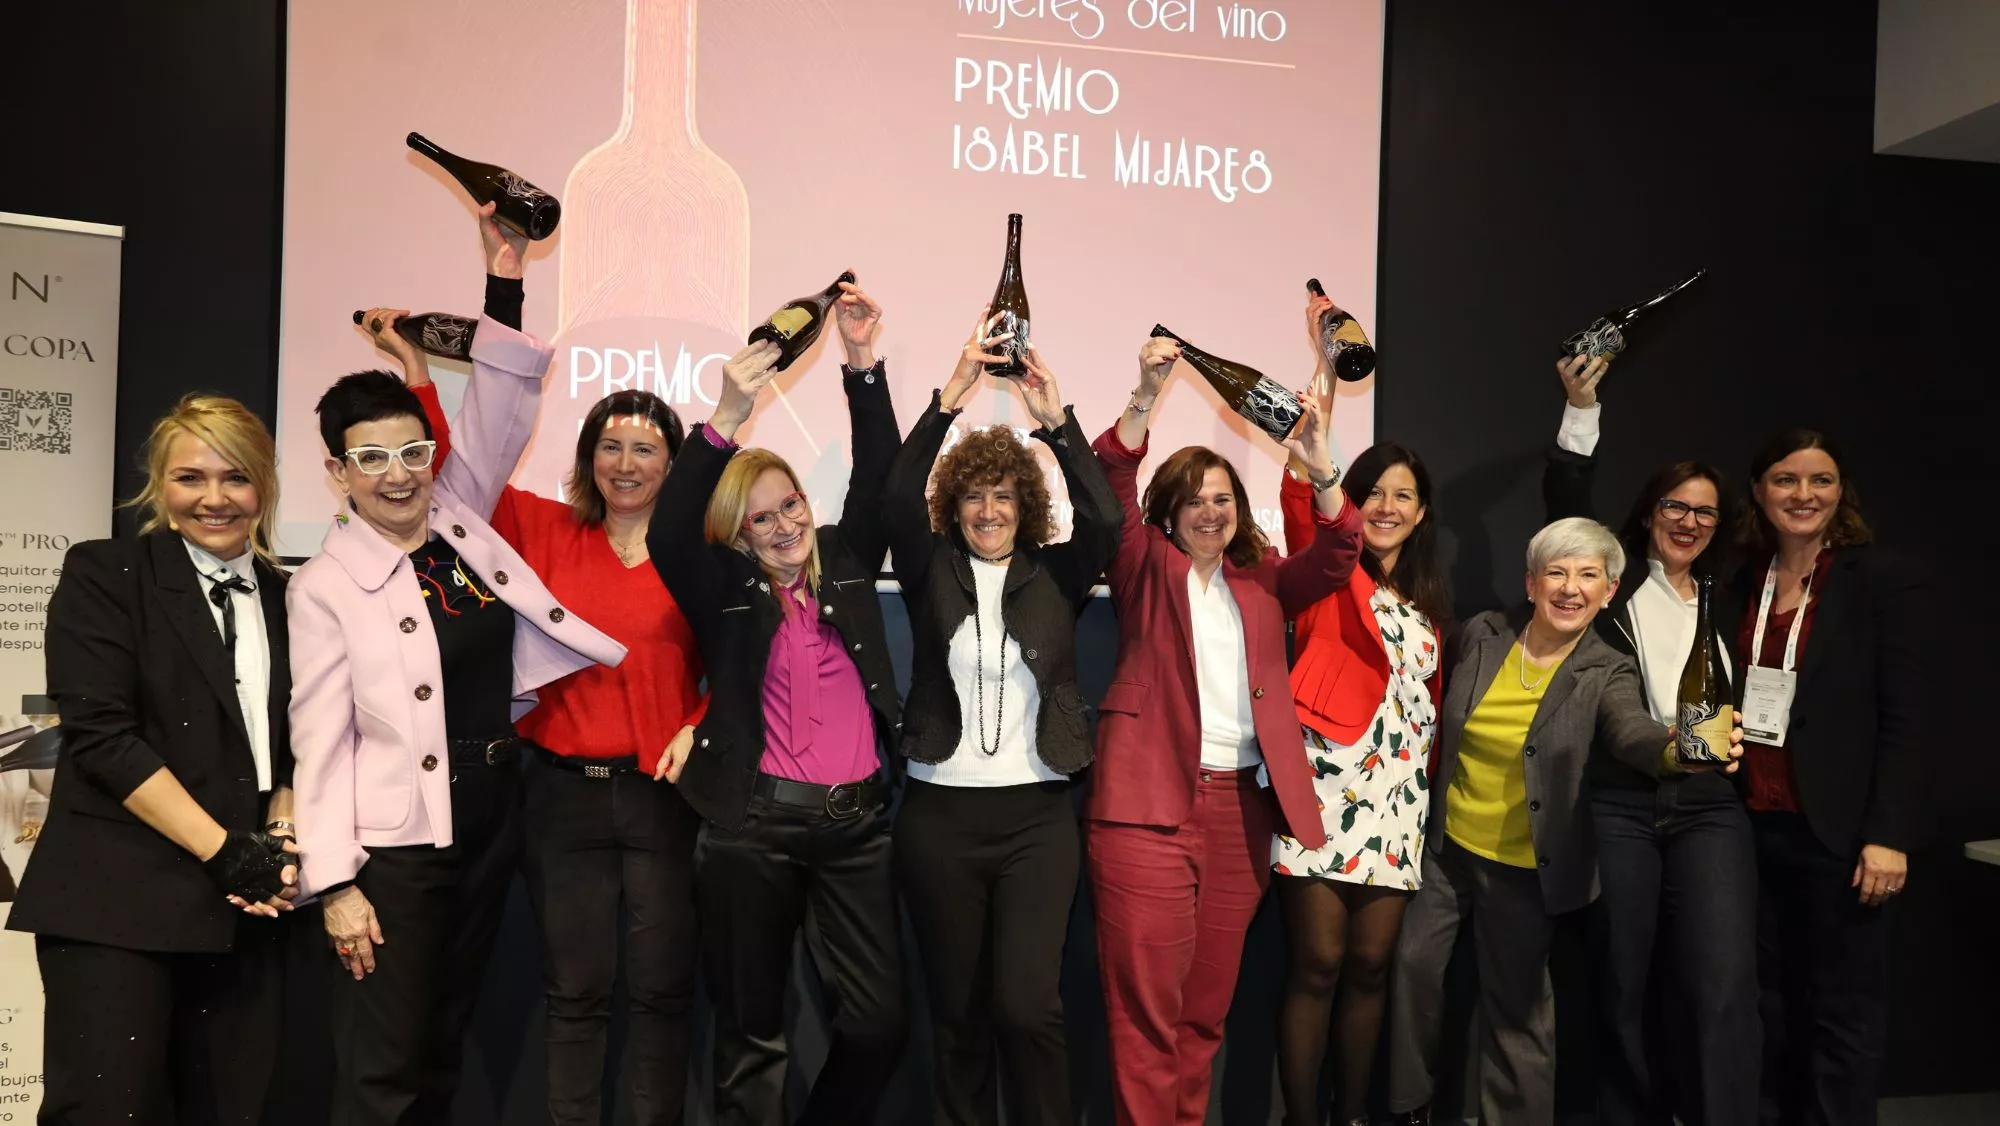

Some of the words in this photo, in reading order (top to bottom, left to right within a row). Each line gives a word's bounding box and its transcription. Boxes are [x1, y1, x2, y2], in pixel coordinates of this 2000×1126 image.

[1217, 2, 1287, 42] vino
[954, 53, 1120, 119] PREMIO
[953, 121, 1087, 179] ISABEL
[1114, 128, 1272, 203] MIJARES
[4, 334, 96, 363] COPA
[23, 533, 70, 551] PRO
[0, 638, 43, 652] espu
[0, 1092, 31, 1104] nte
